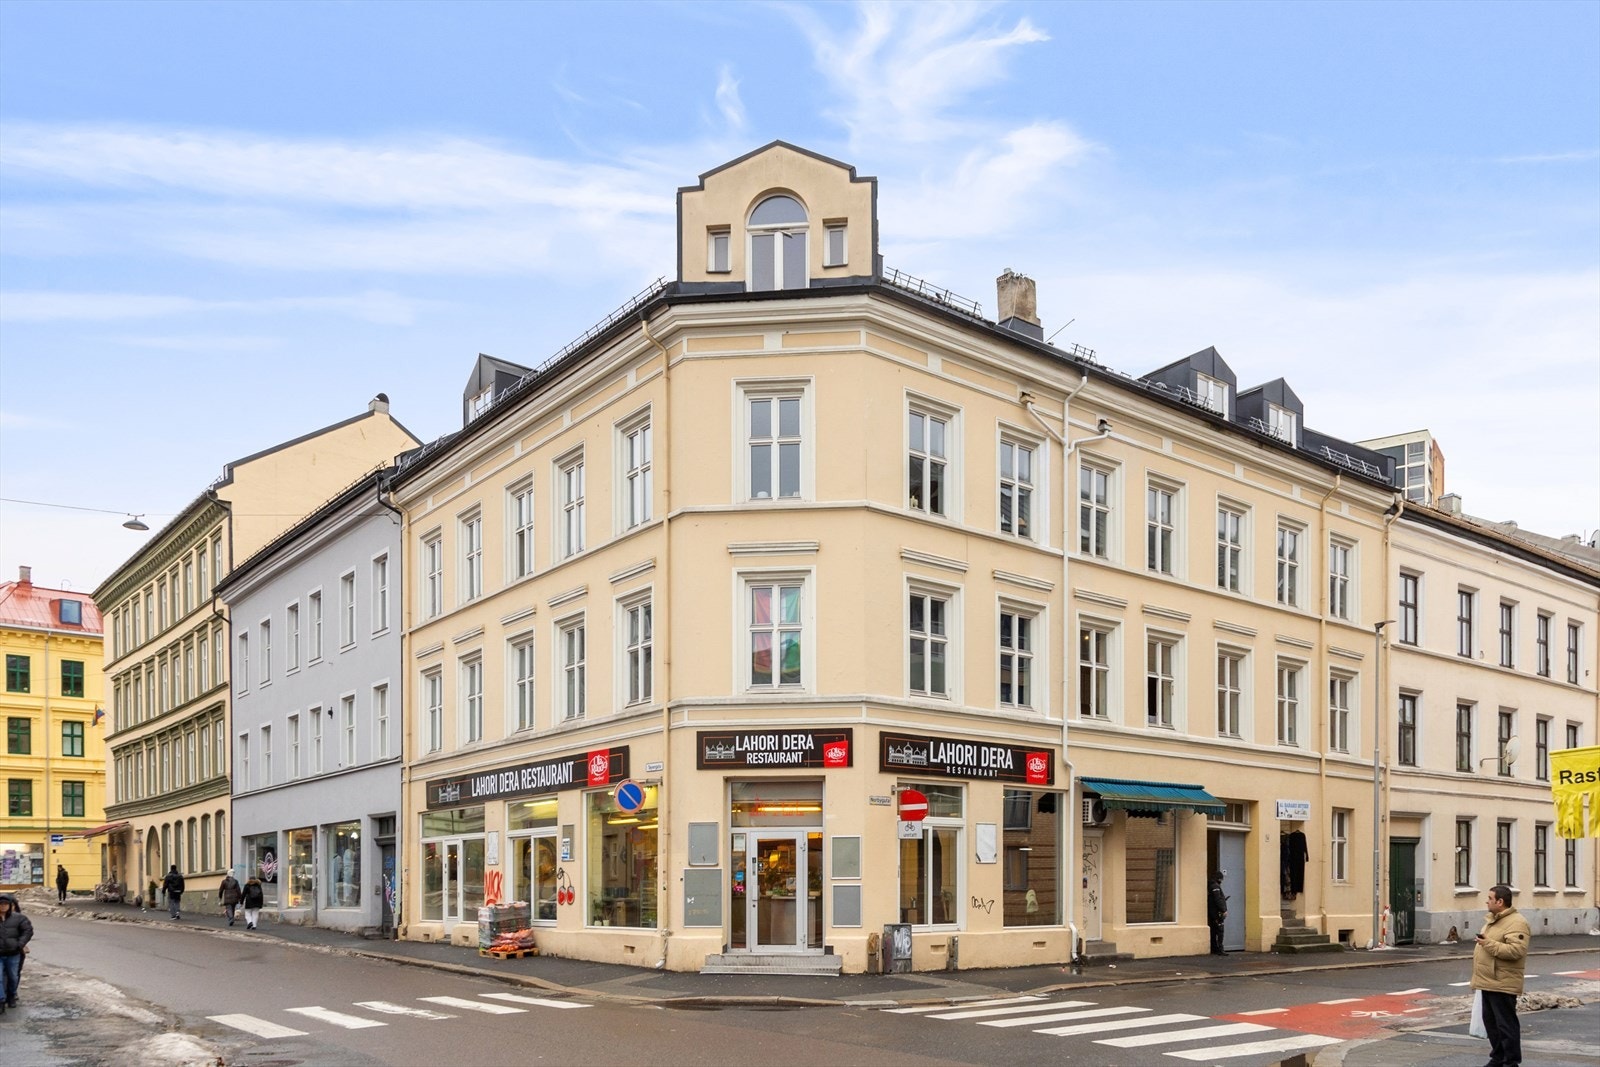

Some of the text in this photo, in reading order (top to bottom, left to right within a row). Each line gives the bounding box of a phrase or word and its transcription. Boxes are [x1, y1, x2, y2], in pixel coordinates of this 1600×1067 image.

[735, 734, 814, 751] LAHORI DERA
[746, 751, 803, 764] RESTAURANT
[930, 741, 977, 766] LAHORI
[981, 746, 1013, 769] DERA
[471, 761, 574, 797] LAHORI DERA RESTAURANT
[946, 765, 998, 777] RESTAURANT
